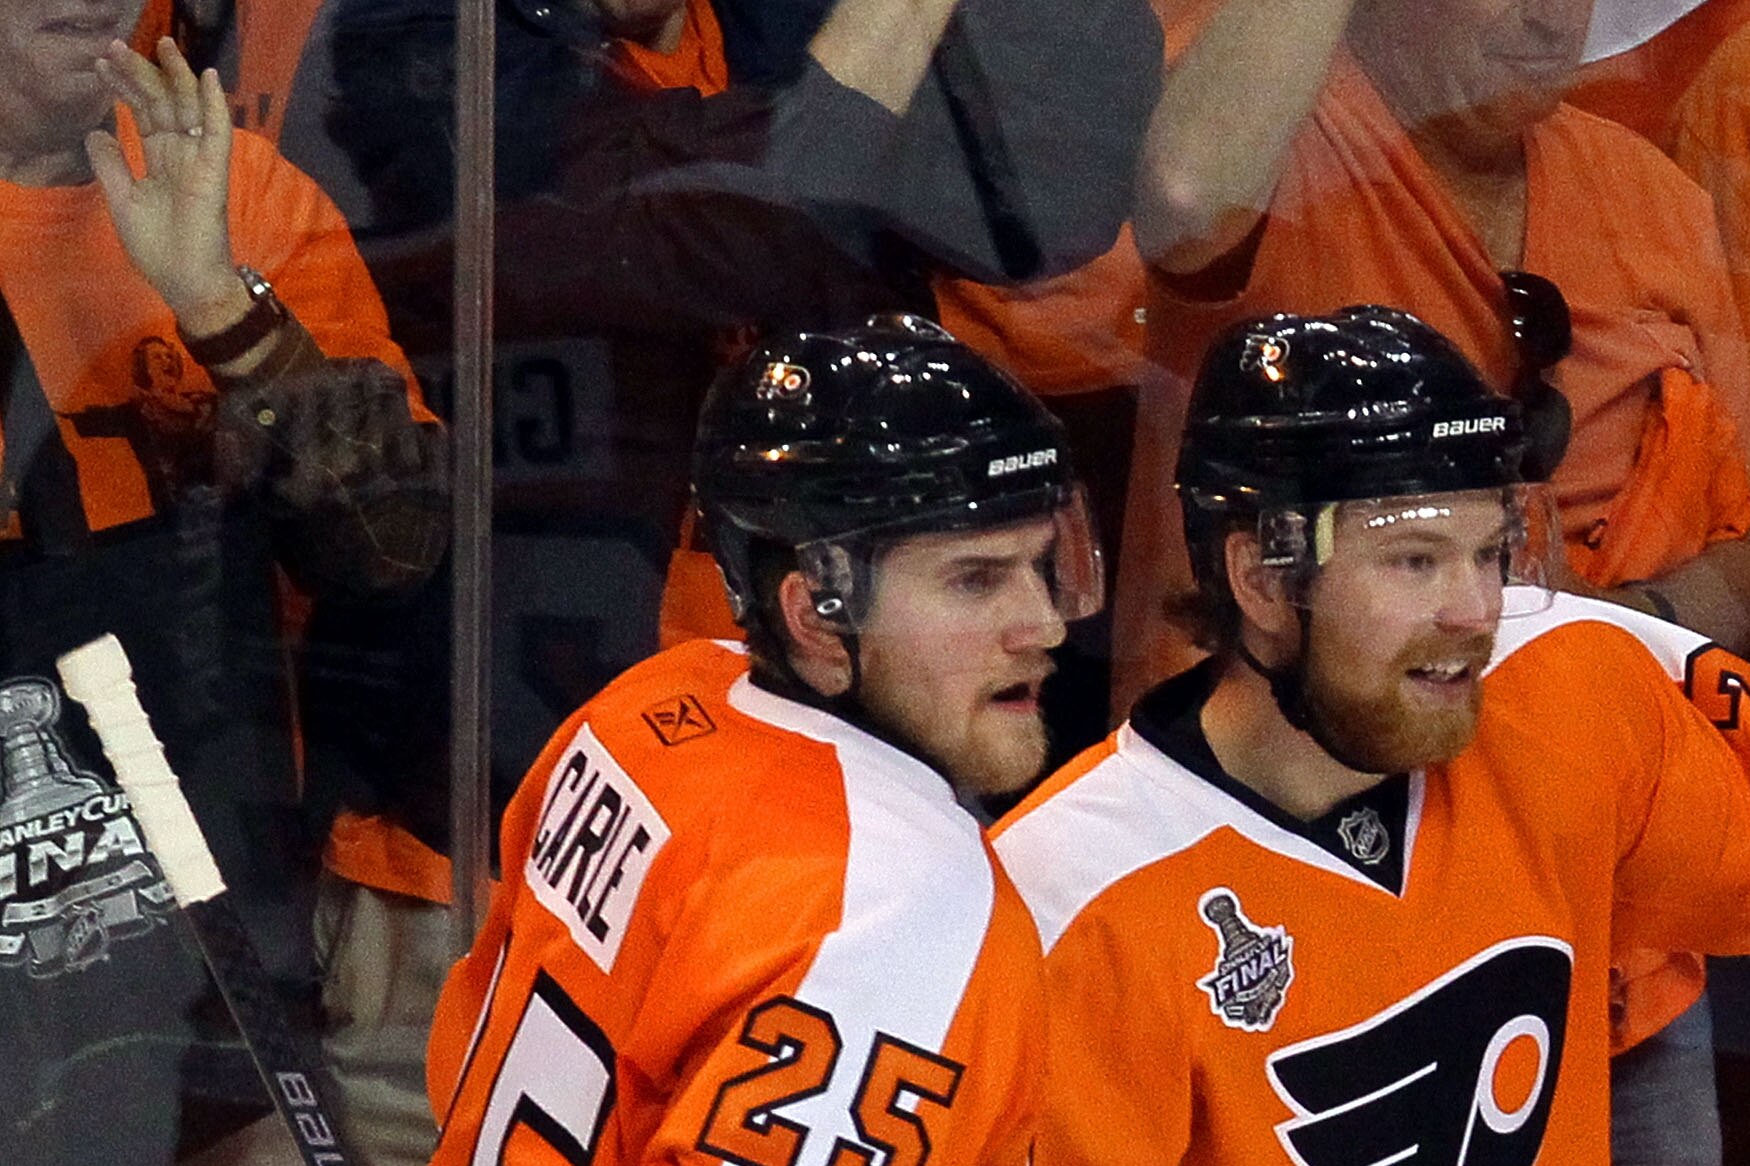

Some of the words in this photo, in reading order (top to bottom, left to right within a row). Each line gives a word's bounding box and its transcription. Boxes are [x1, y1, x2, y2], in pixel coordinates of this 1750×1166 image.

[0, 807, 84, 847] ANLEY
[530, 750, 651, 944] CARLE
[1215, 937, 1287, 1002] FINAL
